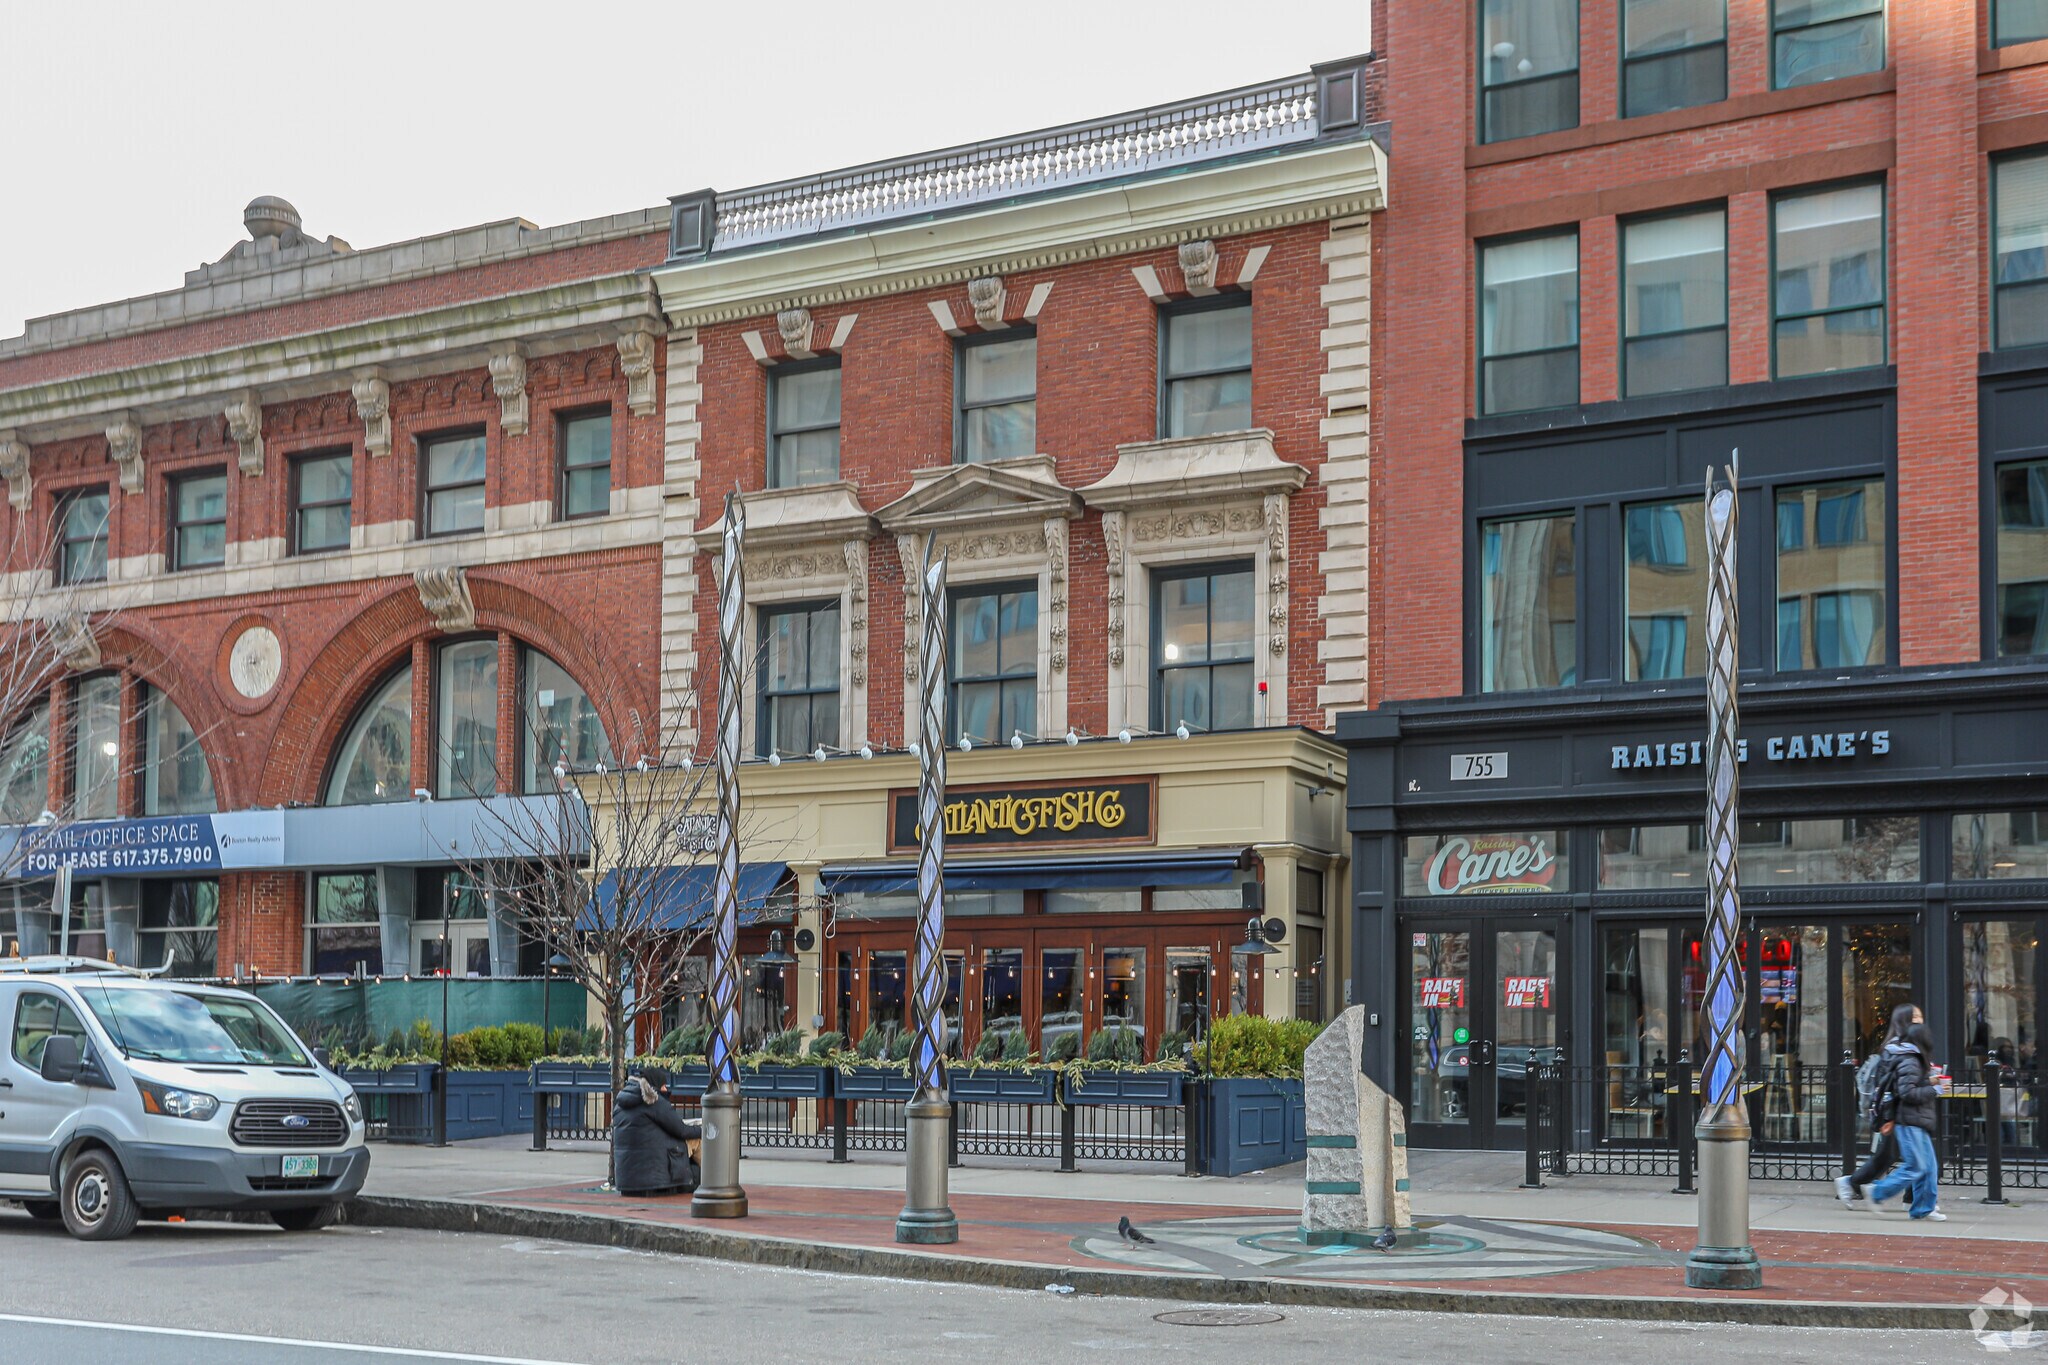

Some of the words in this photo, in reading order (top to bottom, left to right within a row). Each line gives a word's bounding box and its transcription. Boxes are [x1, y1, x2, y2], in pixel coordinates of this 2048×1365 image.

[1611, 739, 1748, 769] RAISIG
[1767, 730, 1890, 760] CANE'S
[1465, 756, 1493, 777] 755
[914, 794, 1037, 841] TLANTIC
[90, 826, 146, 848] OFFICE
[151, 823, 200, 843] SPACE
[1473, 838, 1517, 852] Raising
[28, 853, 57, 871] FOR
[62, 850, 108, 869] LEASE
[112, 846, 213, 868] 617.375.7900
[1427, 834, 1555, 896] Cane's
[1423, 993, 1439, 1007] IN
[1507, 993, 1523, 1007] IN
[289, 1118, 305, 1126] Ford
